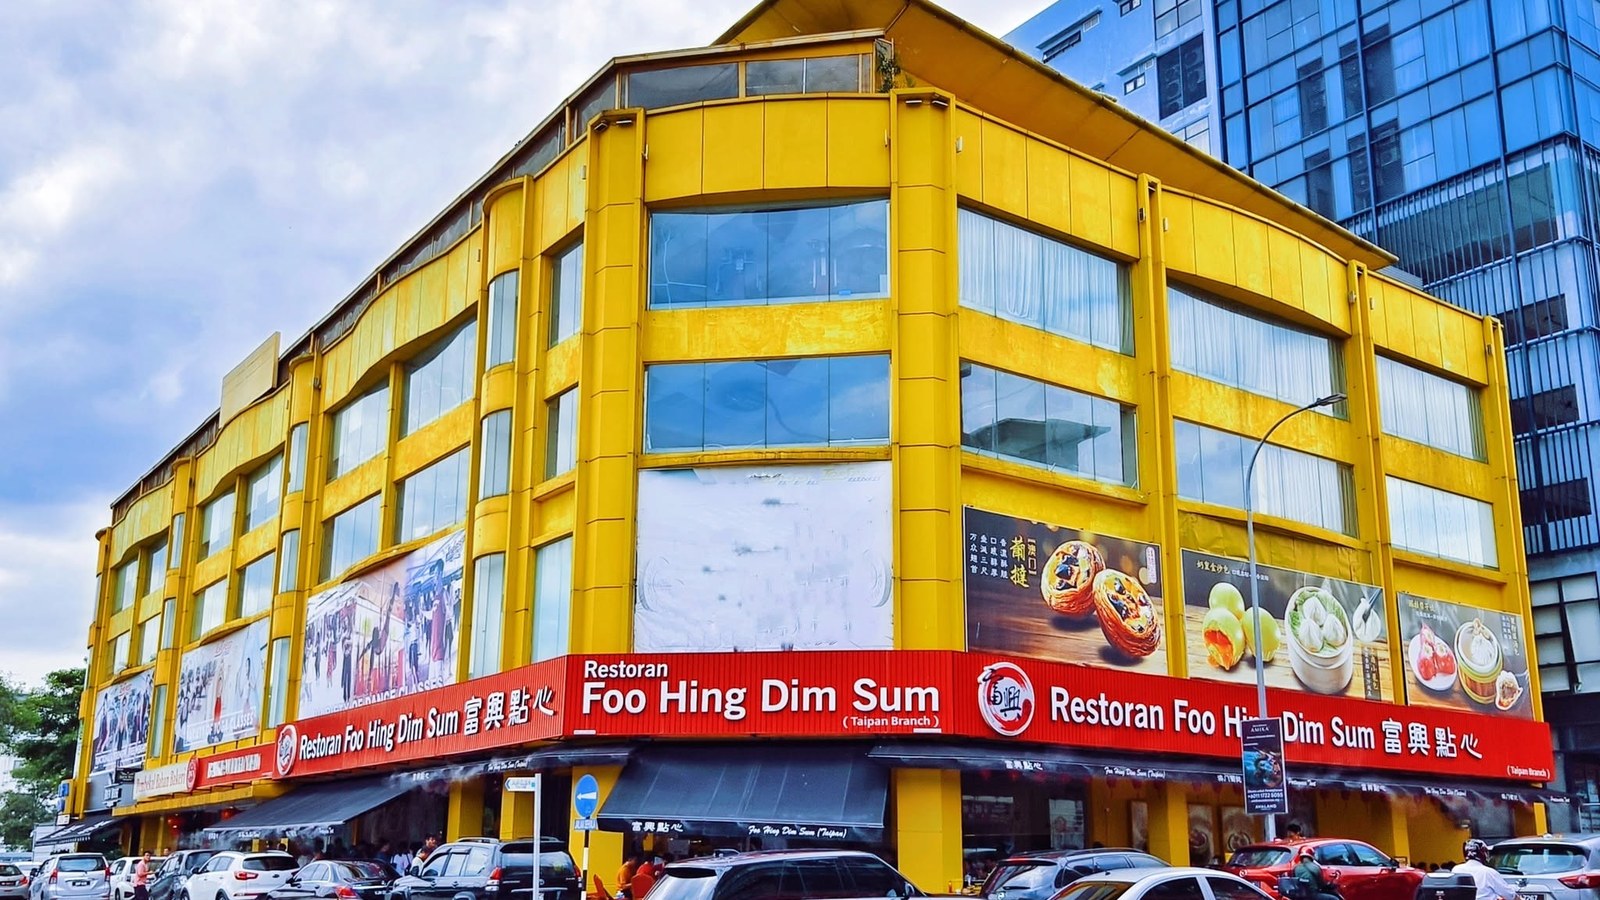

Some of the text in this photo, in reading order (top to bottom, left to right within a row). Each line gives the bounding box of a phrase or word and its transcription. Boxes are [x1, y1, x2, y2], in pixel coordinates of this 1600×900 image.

[584, 660, 668, 679] Restoran
[464, 685, 555, 736] 富興點心
[582, 678, 940, 721] Foo Hing Dim Sum
[1050, 685, 1165, 730] Restoran
[1174, 698, 1216, 736] Foo
[1283, 710, 1325, 745] Dim
[1331, 716, 1375, 749] Sum
[299, 733, 341, 760] Restoran
[345, 724, 364, 752] Foo
[367, 719, 394, 751] Hing
[397, 716, 424, 744] Dim
[427, 707, 459, 738] Sum
[1381, 717, 1483, 760] 富興點心
[631, 820, 683, 833] 富興點心
[748, 825, 848, 839] Foo Hing Dim Sum (Taipan)
